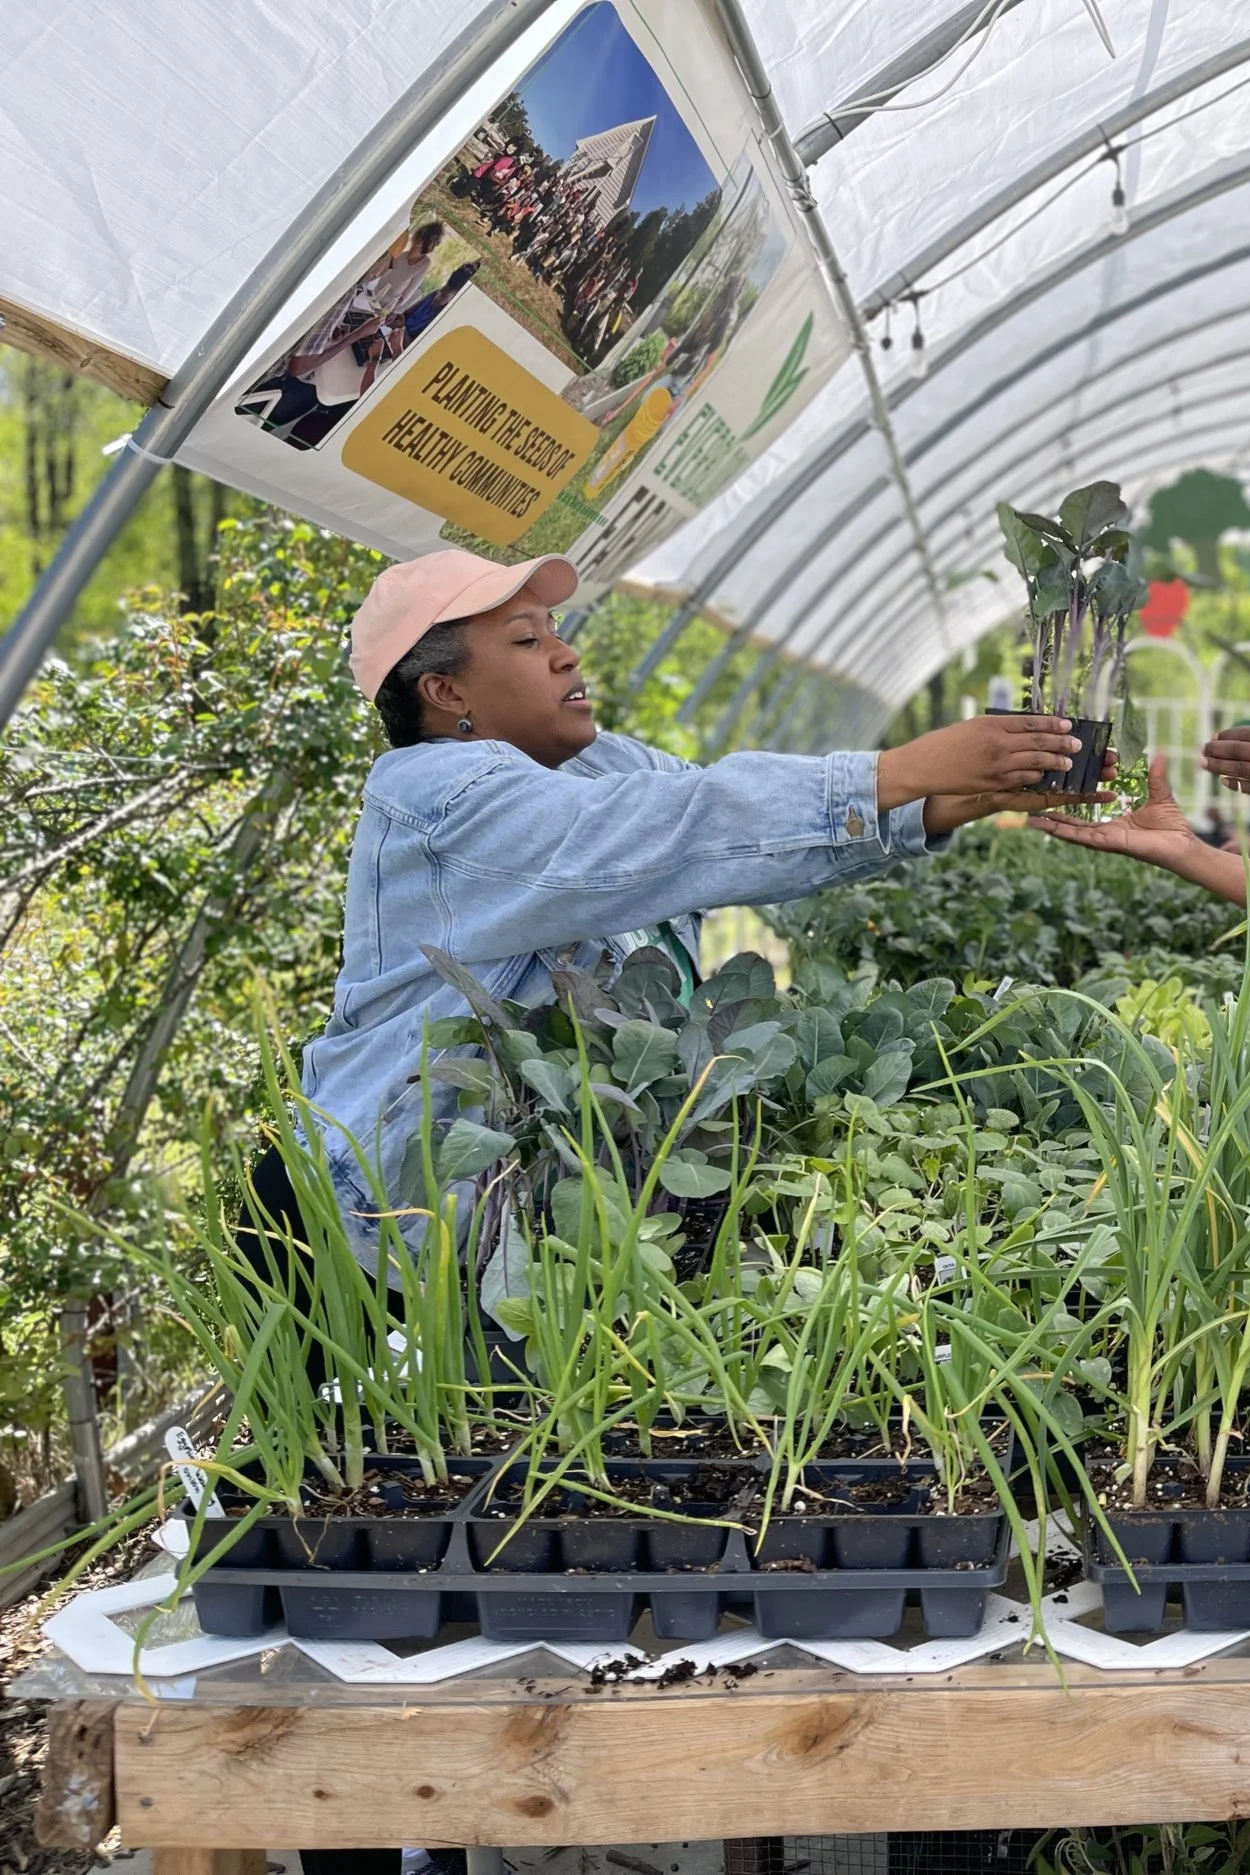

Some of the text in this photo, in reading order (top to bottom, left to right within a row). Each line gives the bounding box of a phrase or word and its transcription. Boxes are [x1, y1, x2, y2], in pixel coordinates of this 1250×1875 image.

[381, 409, 468, 475] HEALTHY
[448, 451, 541, 519] COMMUNITIES
[421, 361, 576, 480] PLANTING THE SEEDS OF
